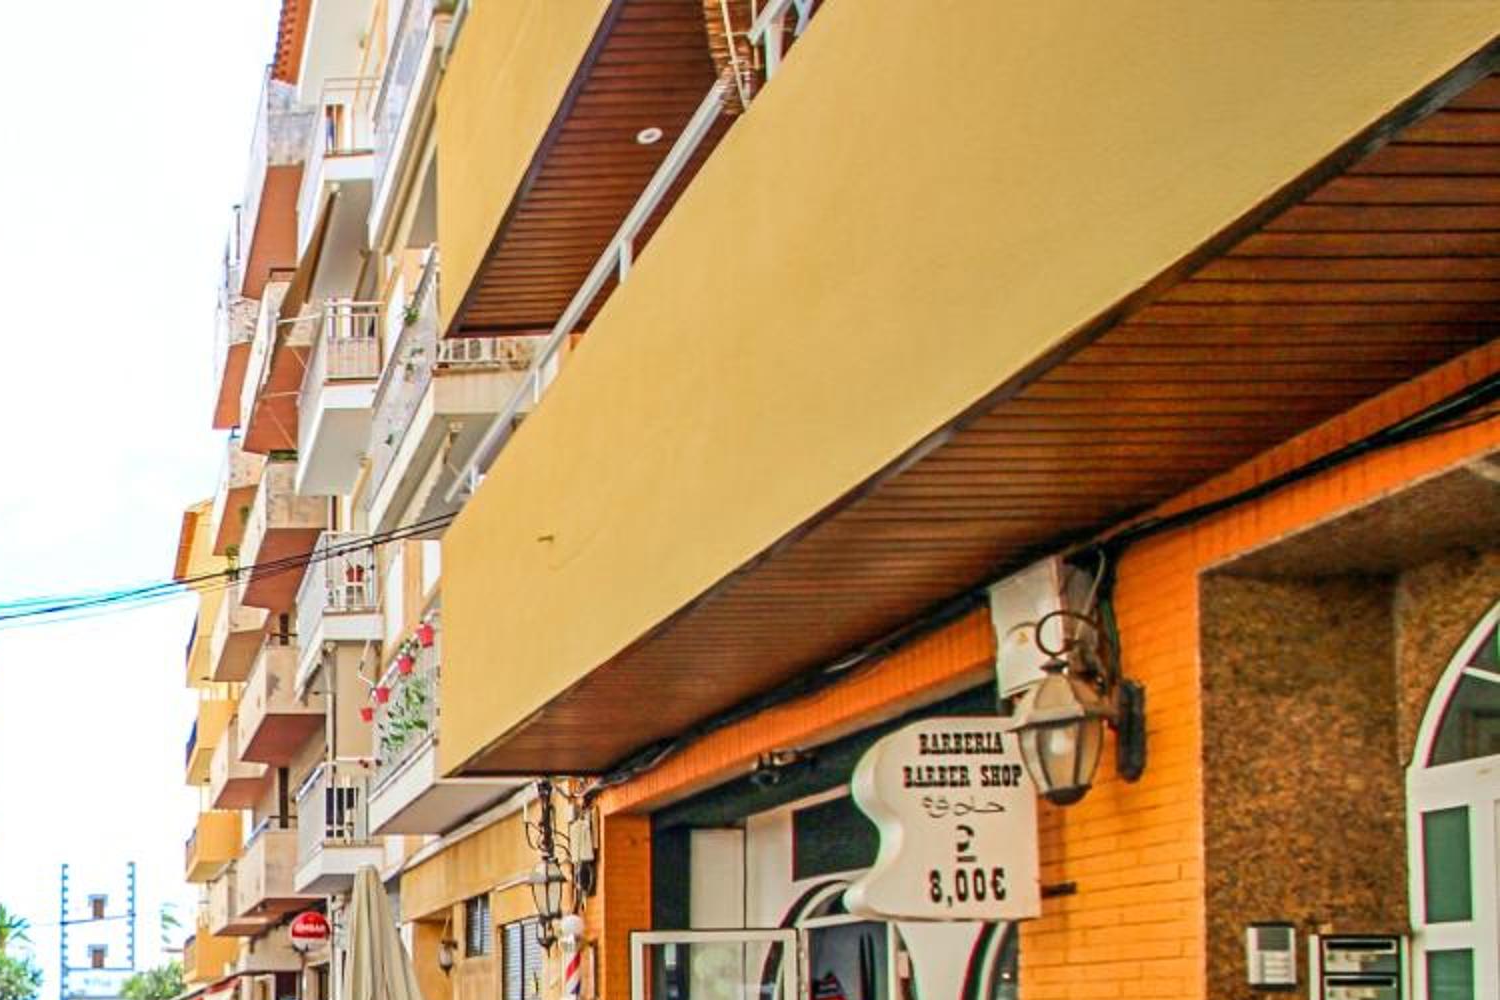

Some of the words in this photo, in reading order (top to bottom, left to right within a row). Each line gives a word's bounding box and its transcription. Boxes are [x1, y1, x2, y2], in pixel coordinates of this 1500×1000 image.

[918, 730, 1005, 755] BARBERIA
[902, 764, 971, 788] BARBER
[980, 763, 1023, 788] SHOP
[929, 867, 1007, 908] 8,00€
